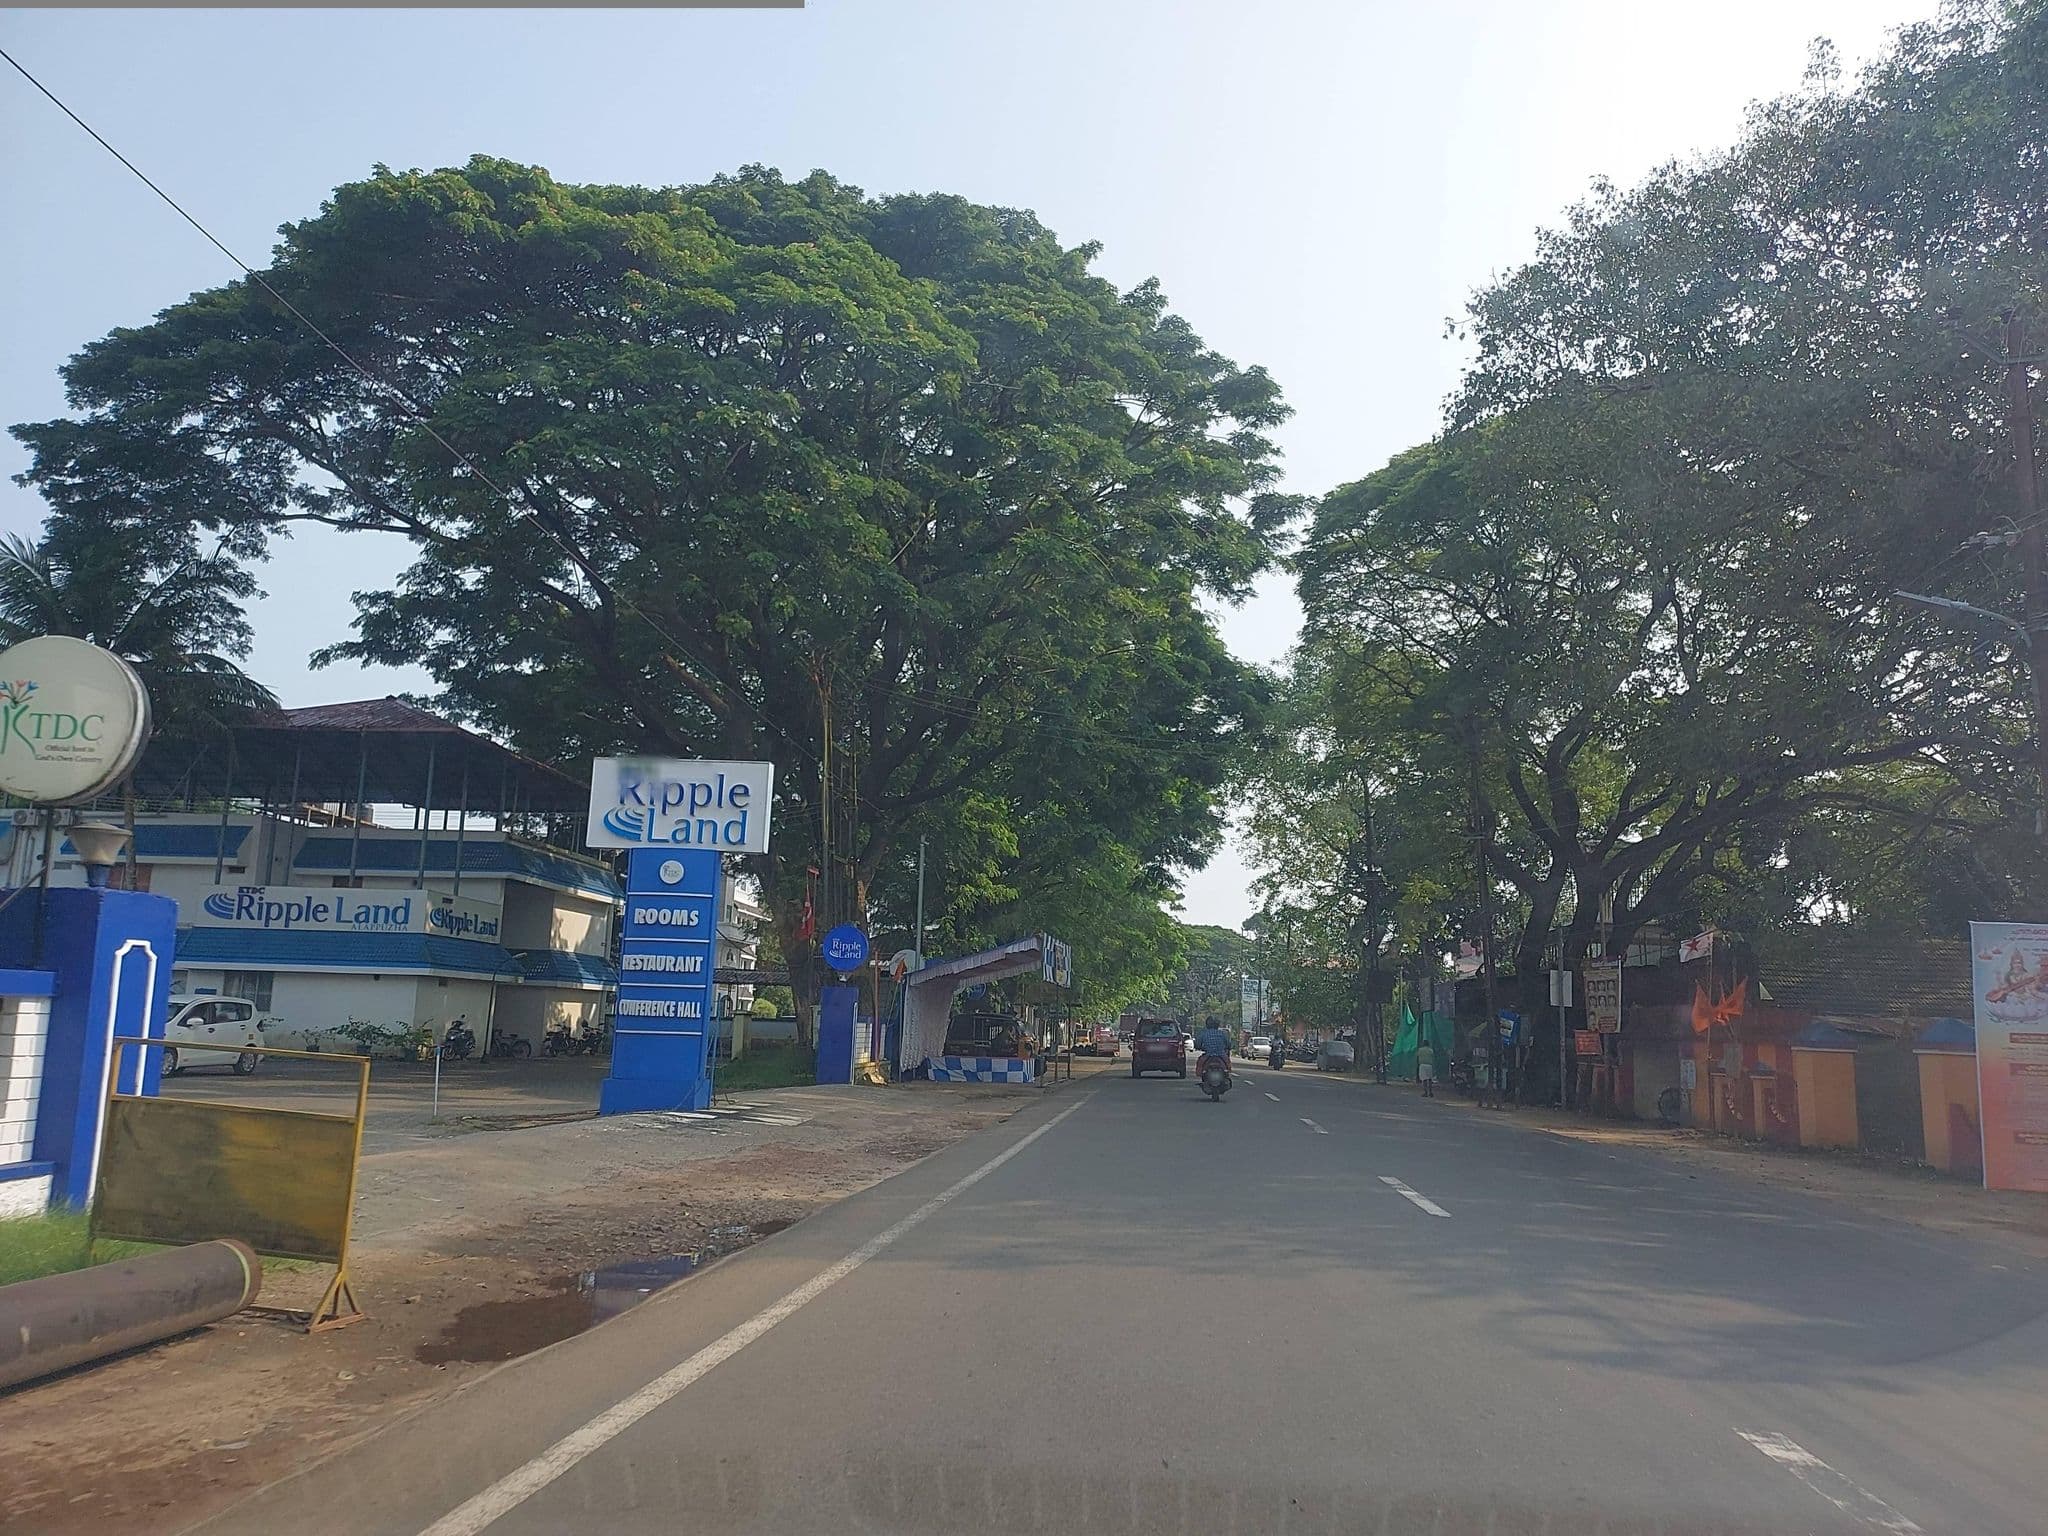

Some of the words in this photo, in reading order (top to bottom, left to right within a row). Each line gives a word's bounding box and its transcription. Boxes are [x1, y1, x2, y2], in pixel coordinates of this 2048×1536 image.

[0, 703, 105, 754] KTDC
[647, 807, 749, 845] Land
[236, 893, 329, 928] Ripple
[335, 896, 411, 925] Land
[633, 908, 699, 926] ROOMS
[473, 913, 498, 936] Land
[832, 940, 861, 952] Ripple
[839, 950, 861, 959] Land
[622, 954, 703, 973] RESTAURANT
[618, 999, 676, 1017] CONFERENCE
[677, 1001, 702, 1018] HALL
